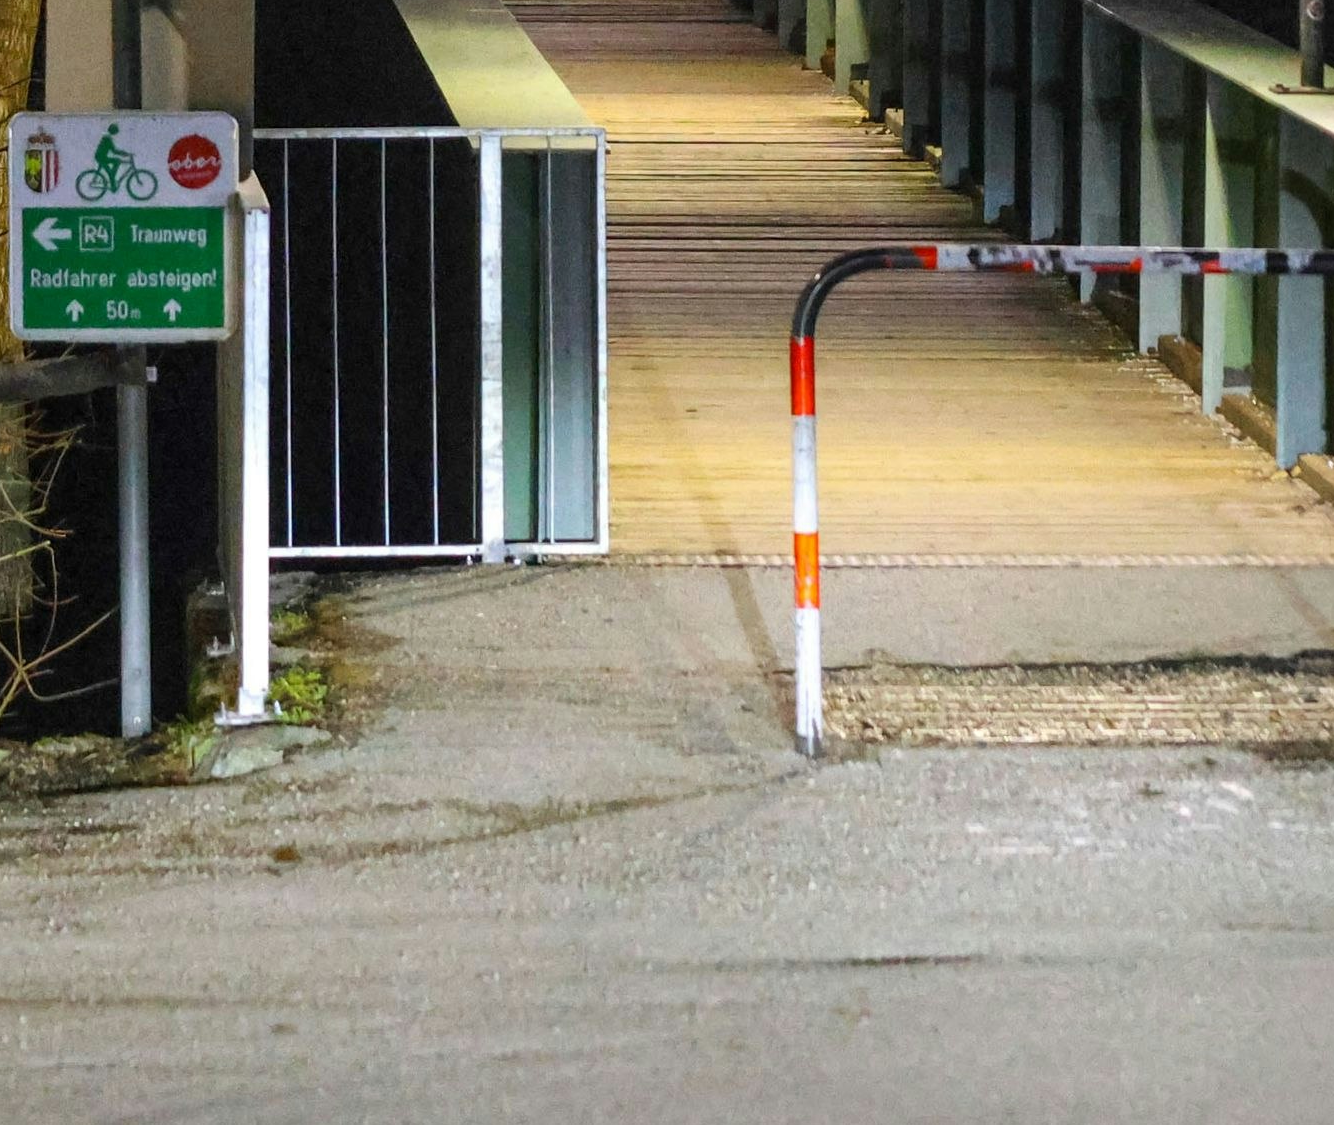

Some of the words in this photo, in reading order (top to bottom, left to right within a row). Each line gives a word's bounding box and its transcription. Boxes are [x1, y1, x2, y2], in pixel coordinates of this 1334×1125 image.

[84, 224, 108, 244] R4
[130, 224, 207, 248] Traunweg
[30, 268, 116, 288] Radfahrer
[127, 268, 217, 291] absteigen!
[106, 300, 128, 320] 50
